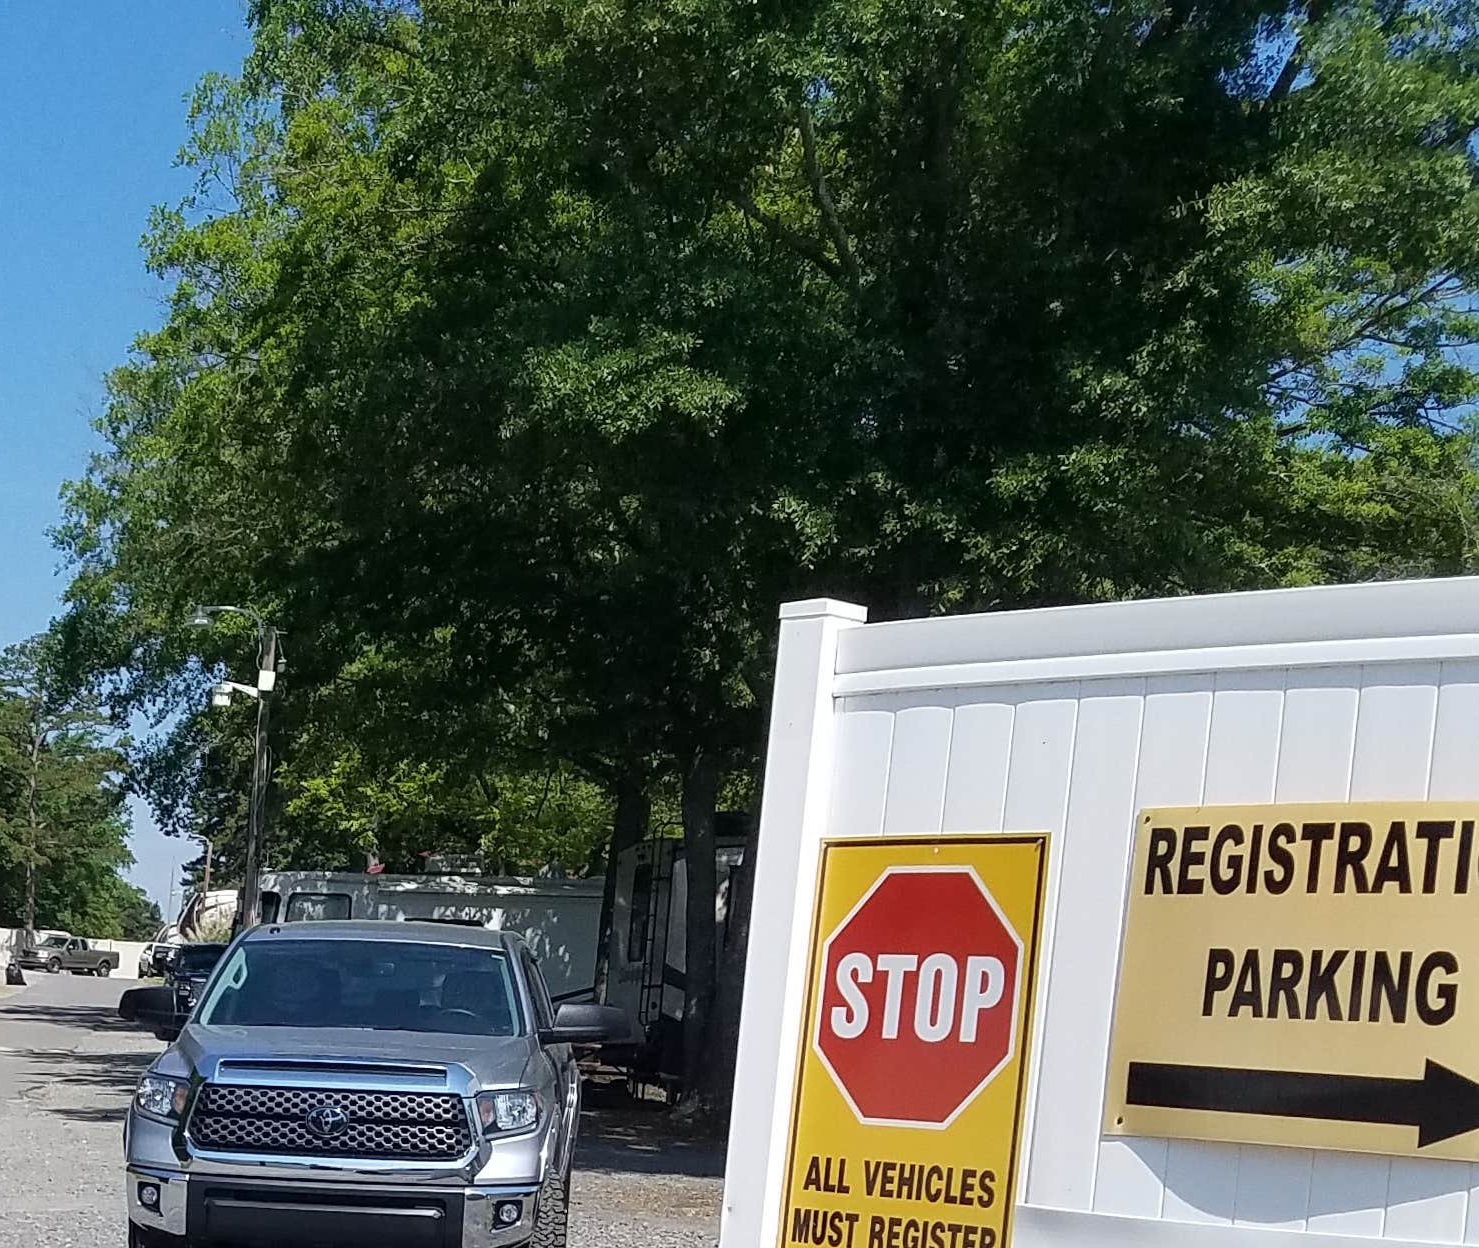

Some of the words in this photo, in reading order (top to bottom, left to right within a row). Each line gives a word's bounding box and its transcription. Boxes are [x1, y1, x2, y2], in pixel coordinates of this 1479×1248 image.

[1143, 820, 1479, 896] REGISTRATI
[830, 952, 1006, 1043] STOP
[1201, 947, 1459, 1026] PARKING
[802, 1156, 851, 1194] ALL
[864, 1160, 996, 1209] VEHICLES
[791, 1207, 860, 1248] MUST
